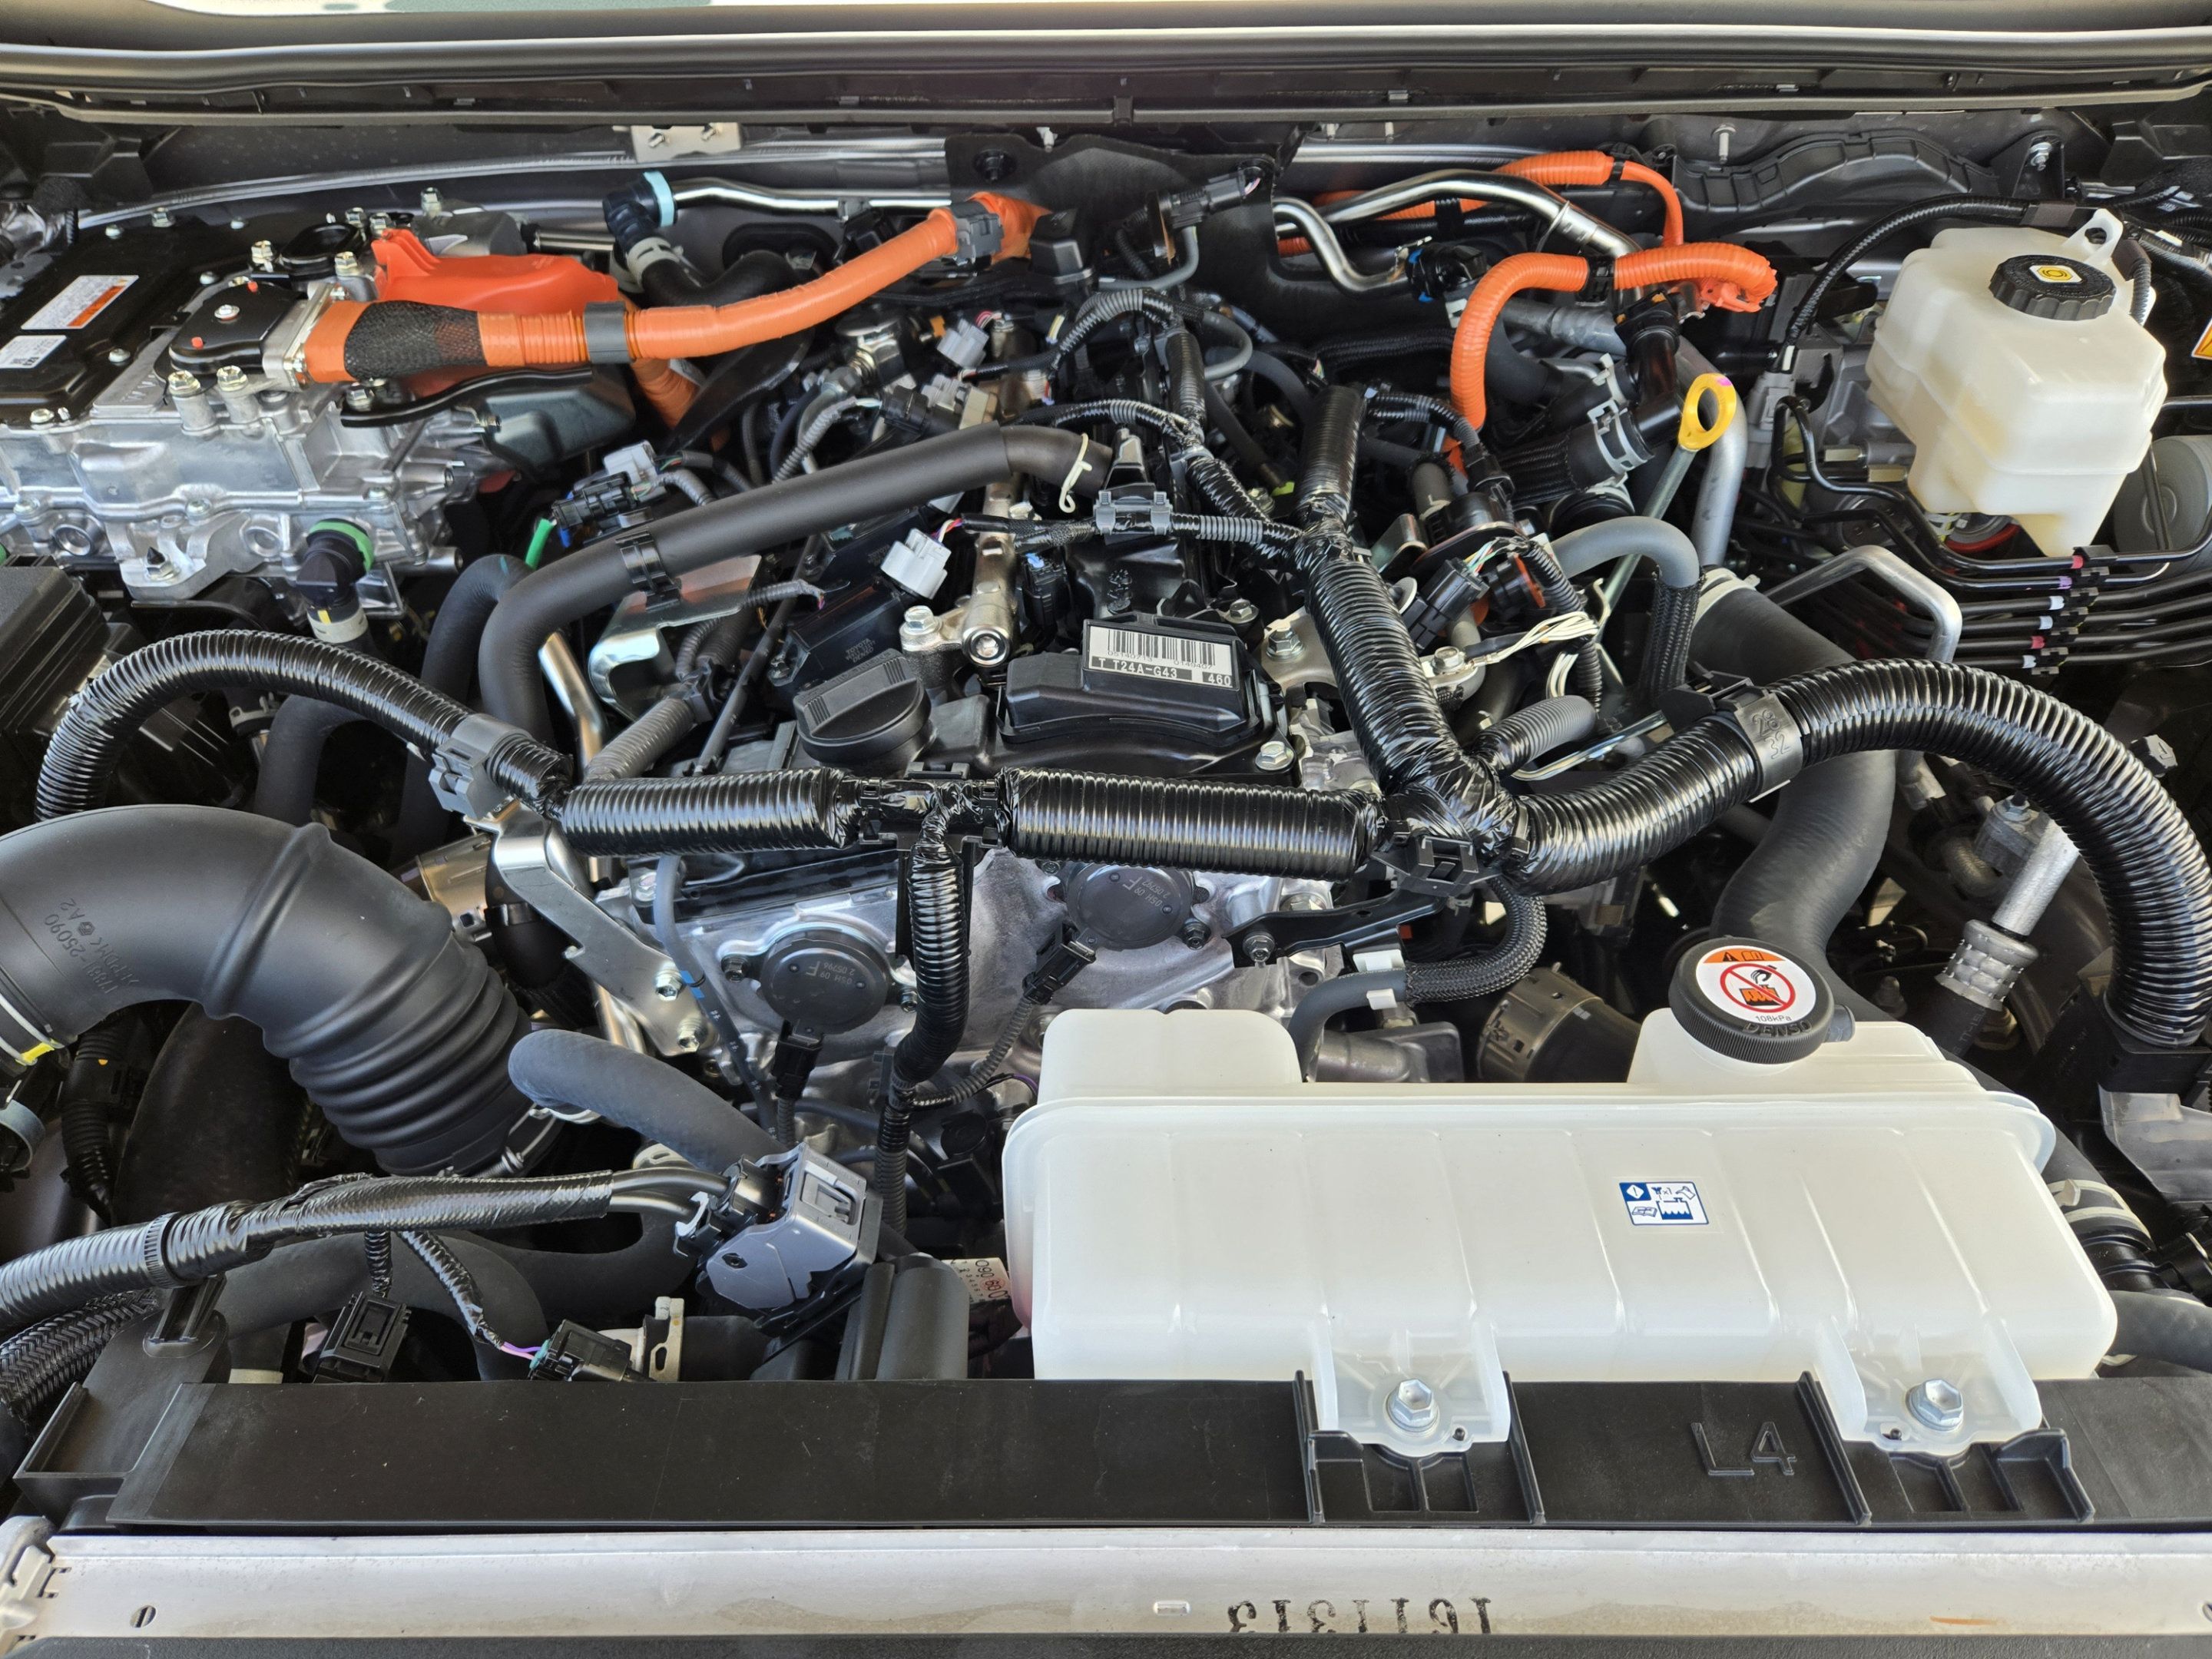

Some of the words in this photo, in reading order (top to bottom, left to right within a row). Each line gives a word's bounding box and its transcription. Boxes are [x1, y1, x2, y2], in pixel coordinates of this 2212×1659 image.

[846, 638, 871, 654] TOYOTA
[1098, 658, 1106, 668] T
[1113, 659, 1178, 679] T24A-G43
[1207, 673, 1232, 685] 460
[1752, 709, 1782, 739] 28
[1764, 730, 1792, 760] 32
[1742, 1020, 1813, 1038] DENSO
[1755, 1015, 1793, 1023] 108kPa
